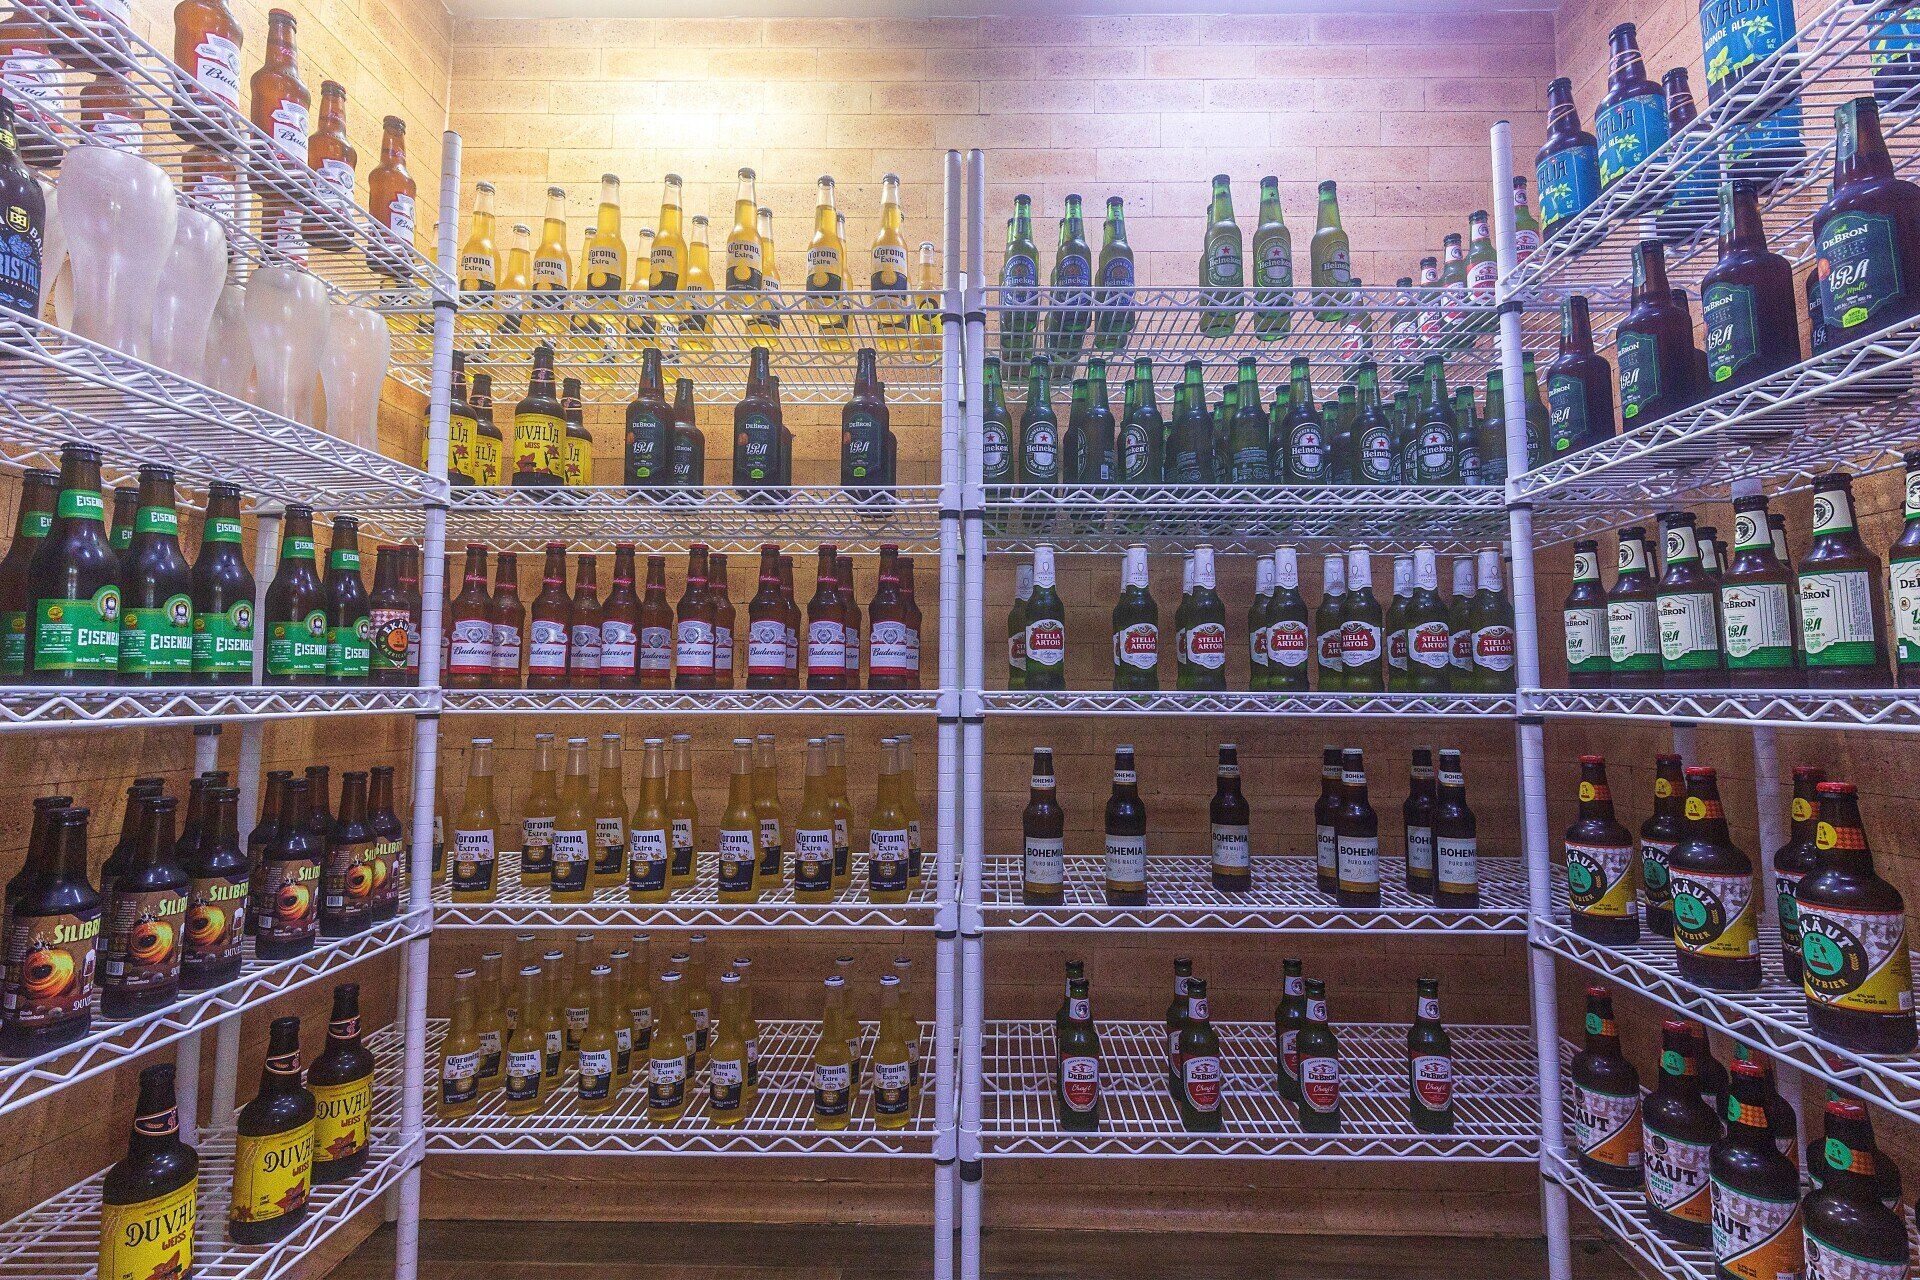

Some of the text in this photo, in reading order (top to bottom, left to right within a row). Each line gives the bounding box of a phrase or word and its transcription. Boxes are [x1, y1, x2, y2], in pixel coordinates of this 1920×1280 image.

[1731, 17, 1747, 33] ALE
[1822, 223, 1869, 251] DEBRON
[728, 242, 761, 256] Corona
[734, 252, 754, 260] Extra
[808, 249, 839, 262] Corona
[874, 247, 905, 260] Corona
[813, 258, 831, 266] Extra
[880, 256, 899, 264] Extra
[464, 264, 484, 272] Extra
[1258, 259, 1292, 270] Heineken
[537, 268, 555, 276] Extra
[1828, 258, 1870, 293] IPA
[1035, 633, 1061, 641] STELLA
[1131, 636, 1155, 644] STELLA
[1197, 636, 1223, 644] STELLA
[1276, 634, 1304, 642] STELLA
[1341, 634, 1368, 642] STELLA
[1421, 635, 1447, 643] STELLA
[1035, 639, 1061, 647] ARTOIS
[1276, 640, 1304, 648] ARTOIS
[1341, 640, 1369, 648] ARTOIS
[1421, 641, 1448, 649] ARTOIS
[1483, 638, 1512, 646] STELLA
[750, 646, 785, 657] Budweiser
[808, 646, 844, 657] Budweiser
[455, 833, 490, 846] Corona
[796, 832, 829, 844] Corona
[871, 831, 906, 844] Corona
[1212, 833, 1248, 843] BOHEMIA
[458, 845, 480, 853] Extra
[555, 844, 573, 852] Extra
[633, 844, 653, 852] Extra
[722, 844, 741, 852] Extra
[801, 843, 821, 852] Extra
[878, 843, 899, 852] Extra
[1105, 845, 1143, 856] BOHEMIA
[1805, 970, 1849, 991] WITBIER
[456, 1062, 475, 1071] Extra
[510, 1061, 526, 1069] Extra
[650, 1058, 683, 1070] Coronita
[816, 1065, 847, 1076] Coronita
[876, 1063, 907, 1074] Coronita
[713, 1069, 728, 1077] Extra
[882, 1072, 899, 1080] Extra
[340, 1112, 362, 1128] WEISS
[161, 1231, 188, 1251] WEISS
